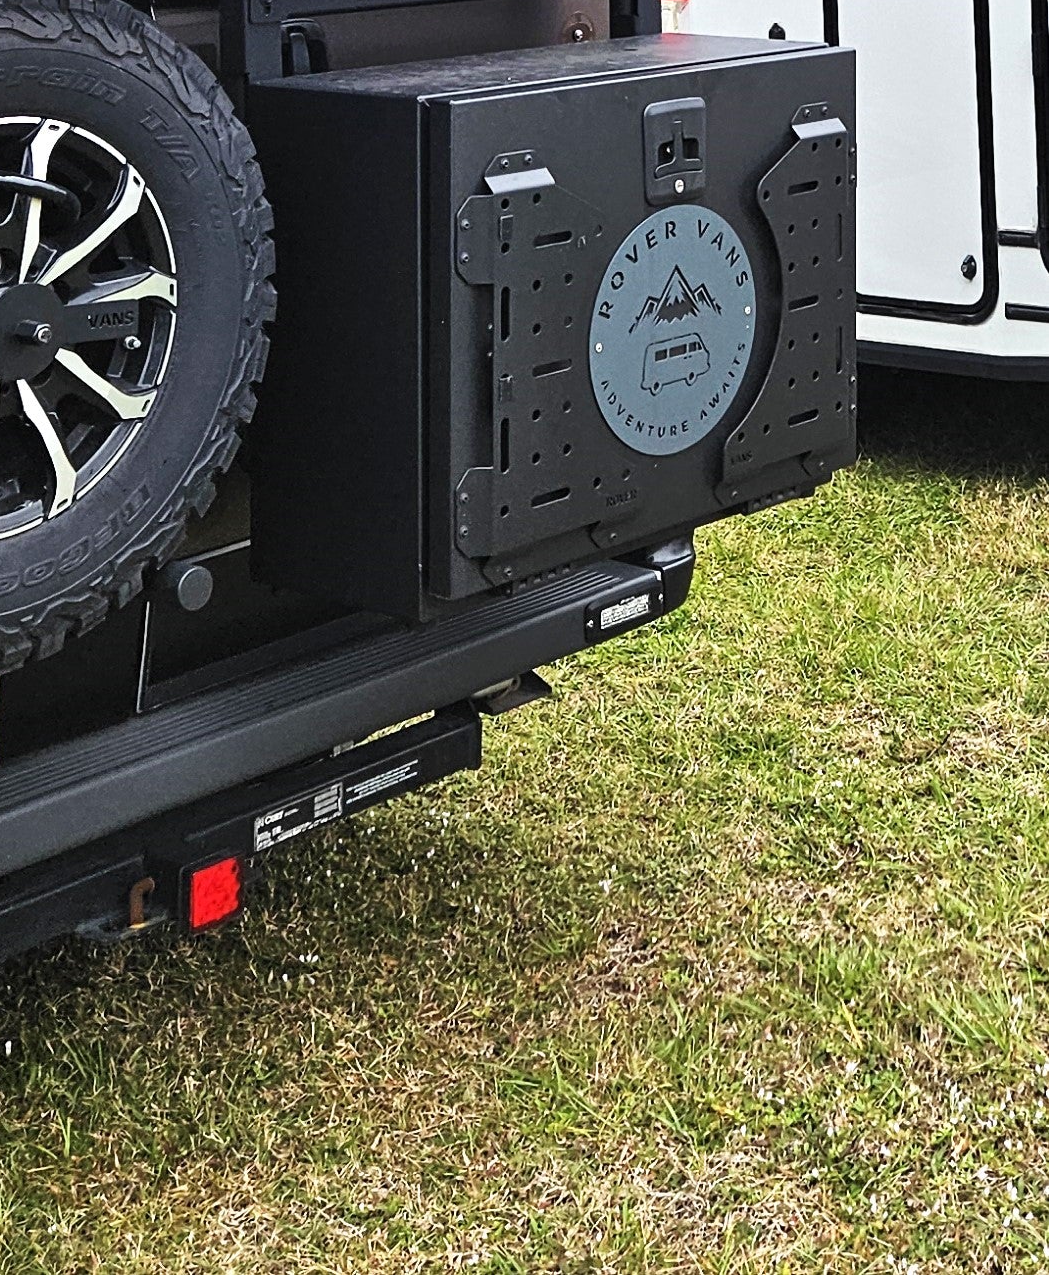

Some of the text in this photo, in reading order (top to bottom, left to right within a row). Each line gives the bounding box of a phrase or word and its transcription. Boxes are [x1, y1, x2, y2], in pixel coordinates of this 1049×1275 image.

[598, 219, 749, 319] ROVER VANS
[88, 310, 135, 328] VANS
[601, 342, 746, 438] ADVENTURE AWAITS
